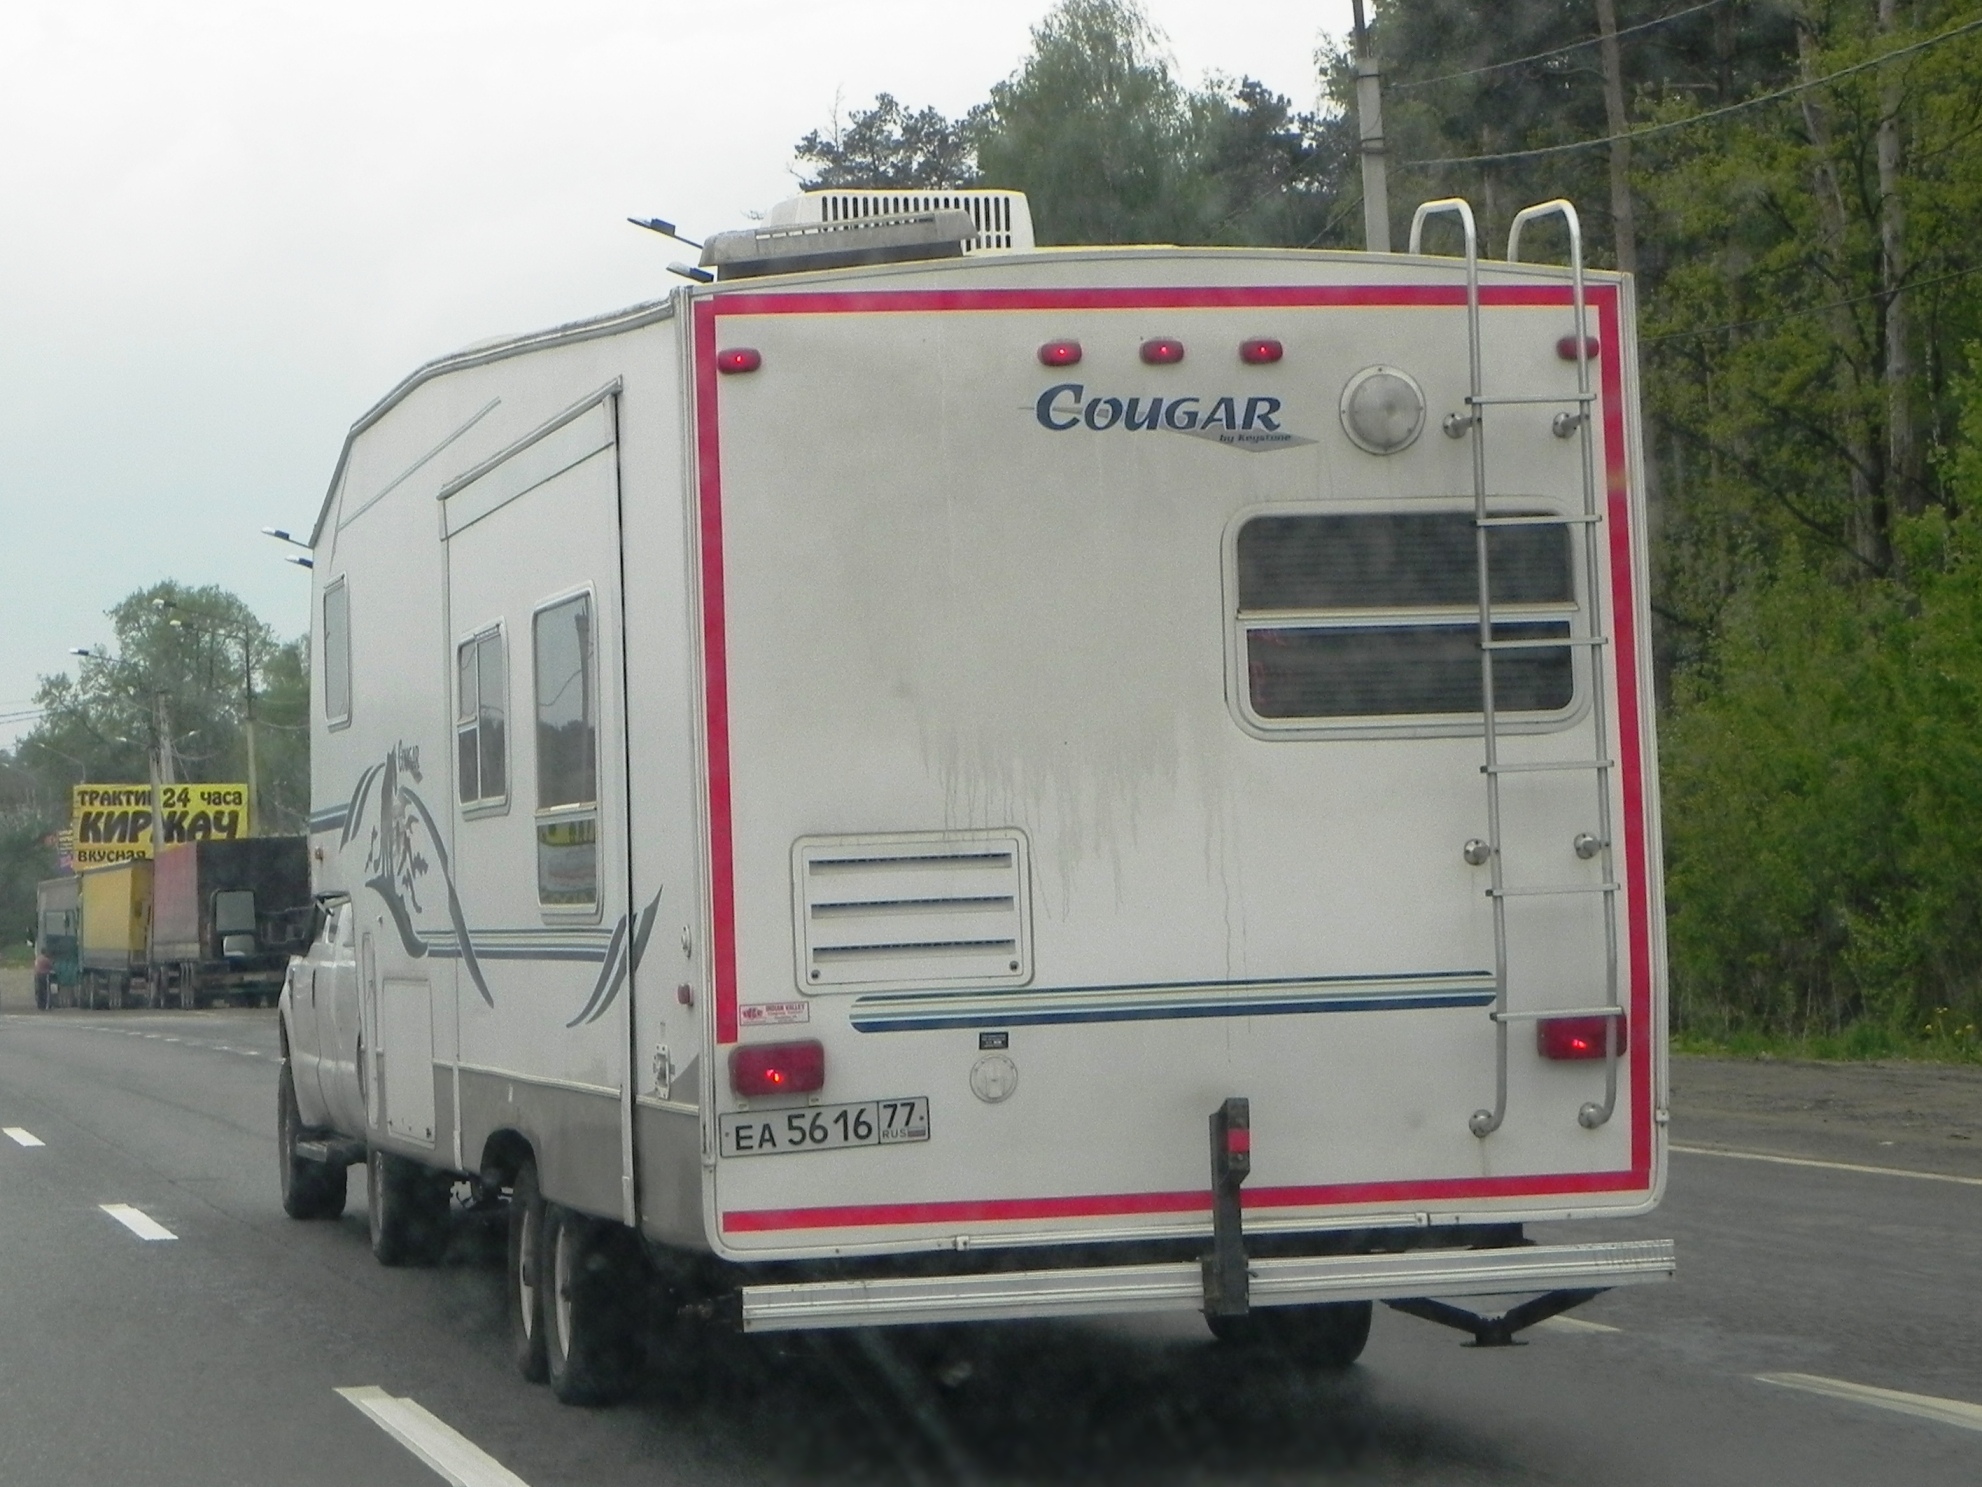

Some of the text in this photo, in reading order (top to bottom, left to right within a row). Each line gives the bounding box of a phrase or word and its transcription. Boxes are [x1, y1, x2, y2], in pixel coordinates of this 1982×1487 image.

[1036, 383, 1282, 432] COUGAR
[77, 787, 242, 809] ТРАКТИ 24 часа
[882, 1101, 916, 1129] 77
[882, 1128, 907, 1139] RUS
